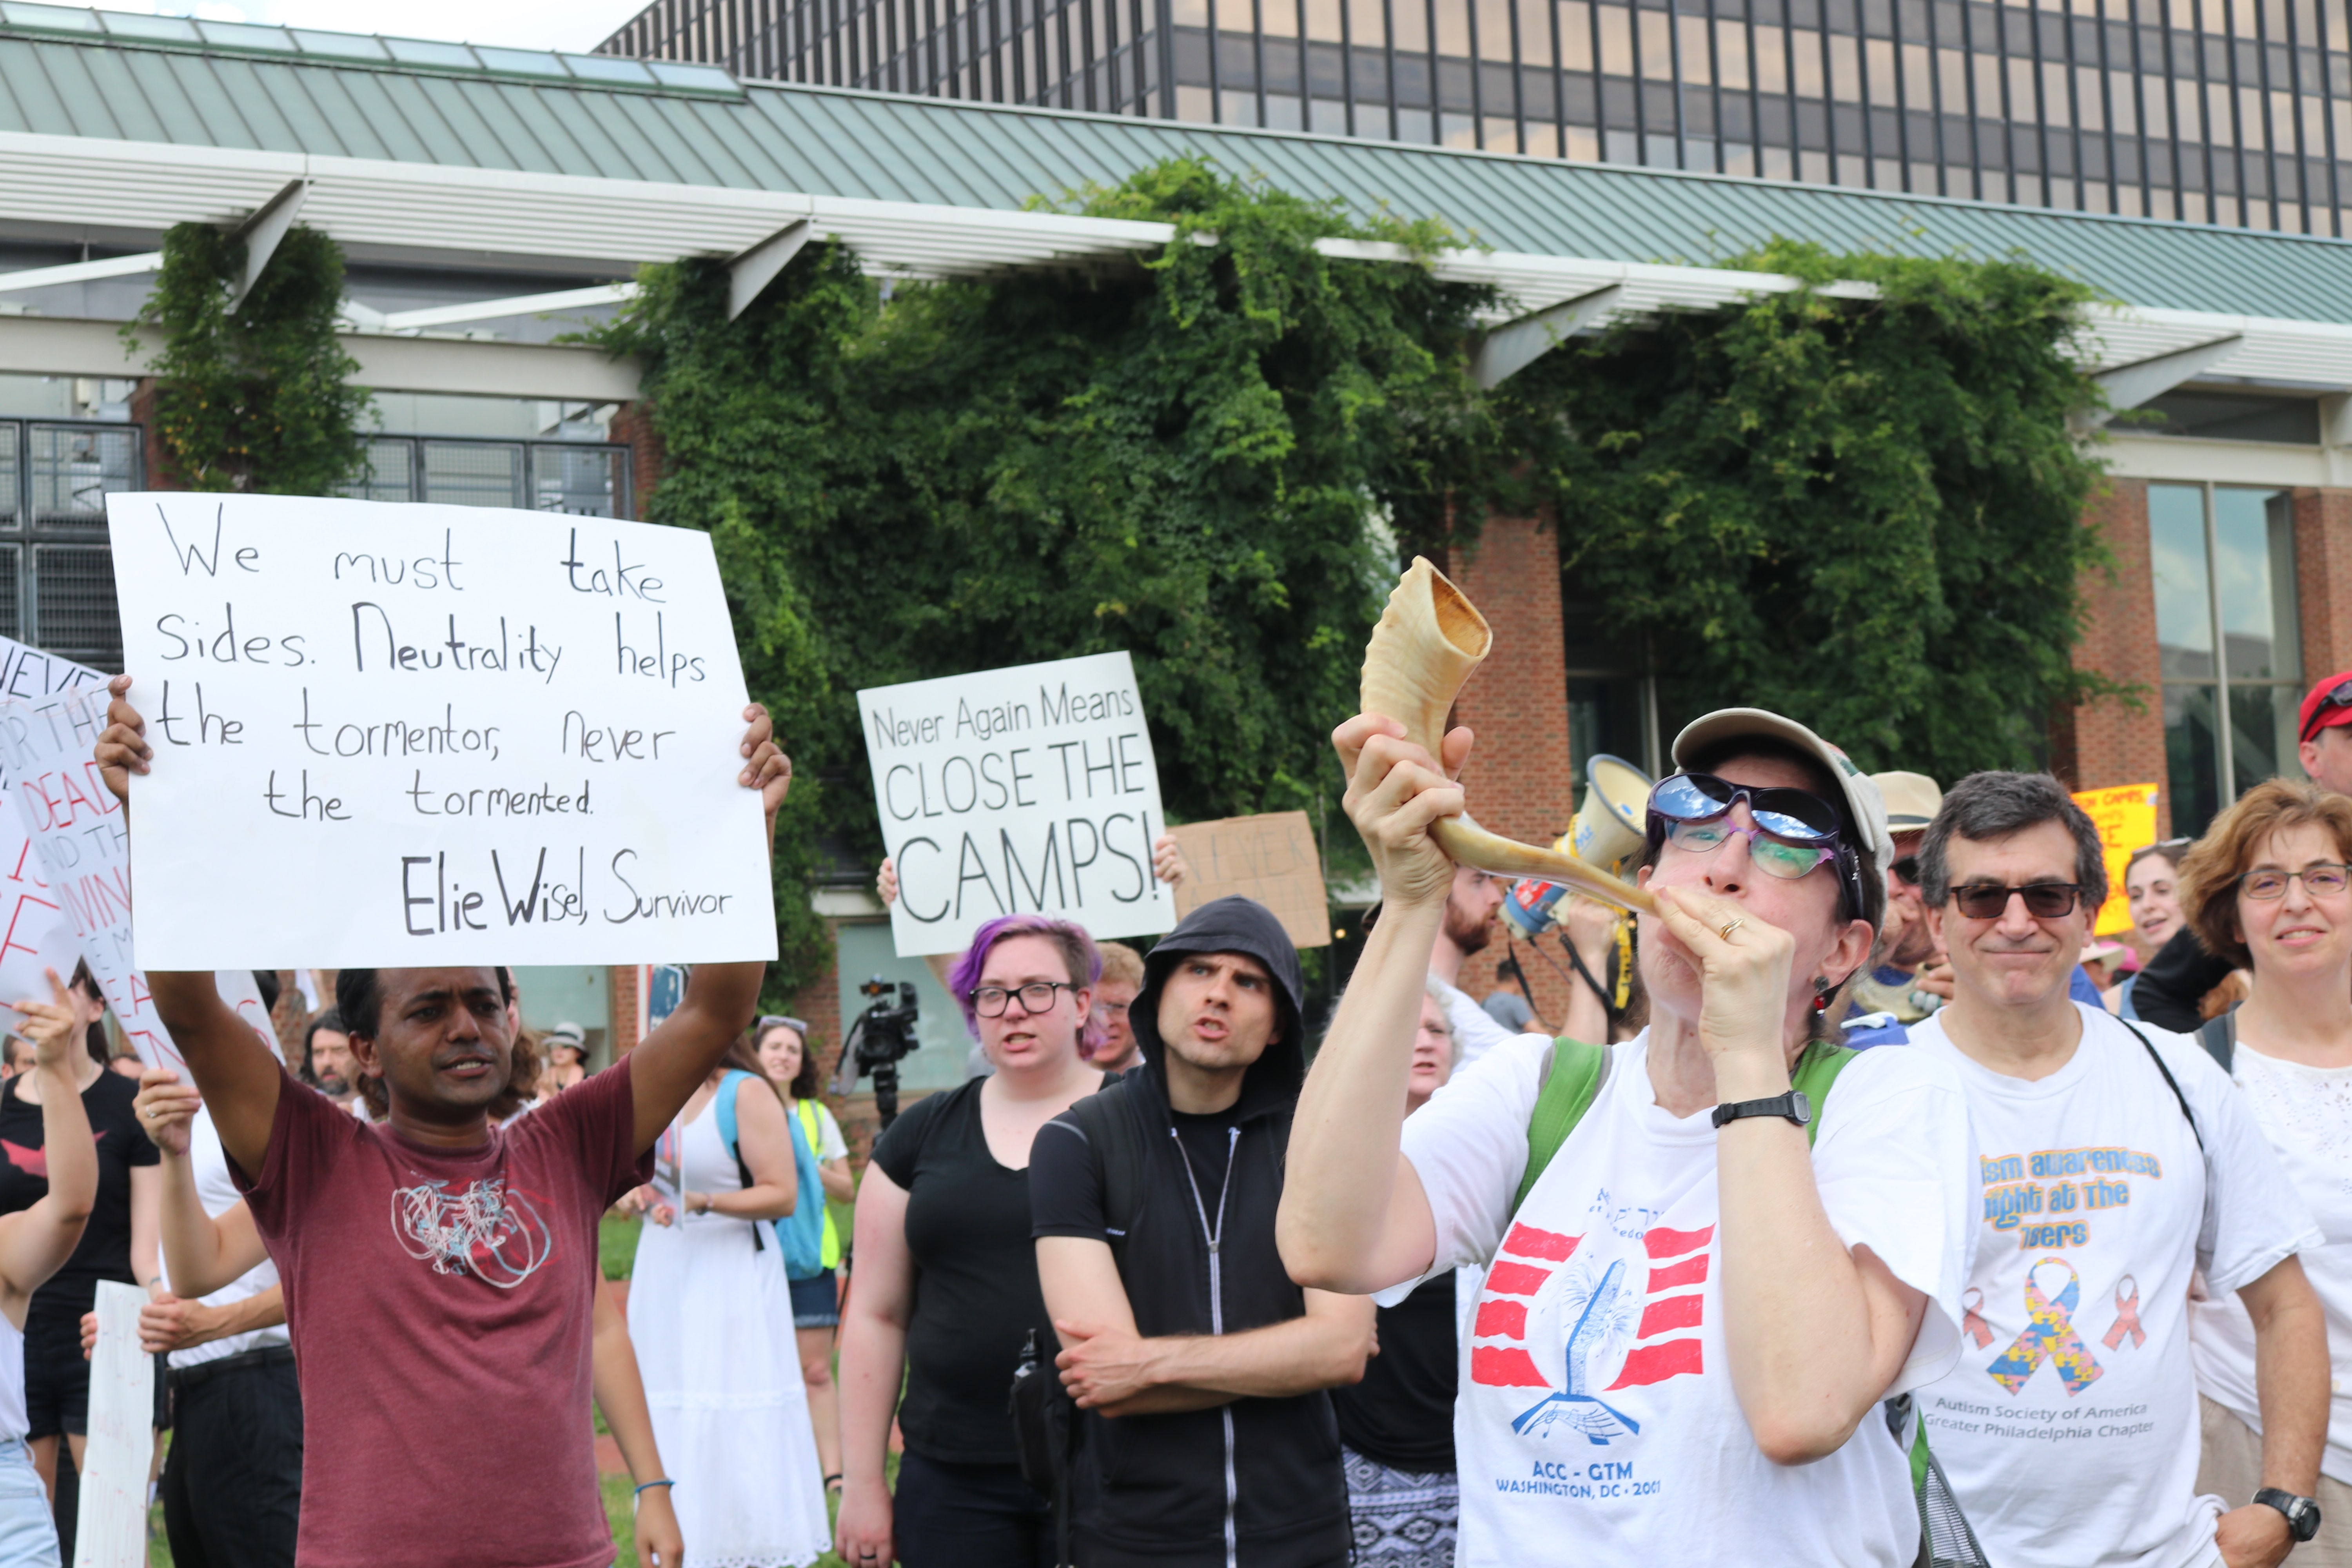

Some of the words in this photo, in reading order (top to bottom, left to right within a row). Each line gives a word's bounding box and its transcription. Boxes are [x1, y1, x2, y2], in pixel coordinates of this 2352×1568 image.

[156, 502, 260, 577] We
[334, 528, 463, 590] must
[560, 527, 666, 603] take
[351, 602, 561, 684] Neutrality
[615, 611, 705, 688] helps
[155, 680, 243, 746] the
[293, 687, 500, 761] tormentor,
[872, 708, 942, 750] Never
[955, 697, 1031, 741] Again
[1041, 682, 1133, 726] Means
[263, 769, 352, 821] the
[405, 769, 593, 817] tormented.
[887, 749, 1035, 820] CLOSE
[1047, 734, 1143, 801] THE
[401, 851, 487, 936] Elie
[491, 846, 588, 926] Wisel,
[603, 848, 732, 924] Survivor
[897, 811, 1159, 924] CAMPS!
[2028, 1147, 2163, 1179] awareness
[2048, 1180, 2079, 1214] at
[2081, 1176, 2130, 1210] The
[1924, 1413, 1980, 1433] Greater
[1984, 1423, 2092, 1443] Philadelphia
[2098, 1421, 2154, 1438] Chapter
[1936, 1397, 1990, 1416] Autism
[1995, 1406, 2057, 1423] Society
[2062, 1407, 2081, 1419] of
[2084, 1403, 2147, 1419] America
[1496, 1479, 1595, 1500] WASHINGTON,
[1600, 1485, 1620, 1498] DC
[1532, 1461, 1568, 1480] ACC
[1588, 1461, 1633, 1481] GTM
